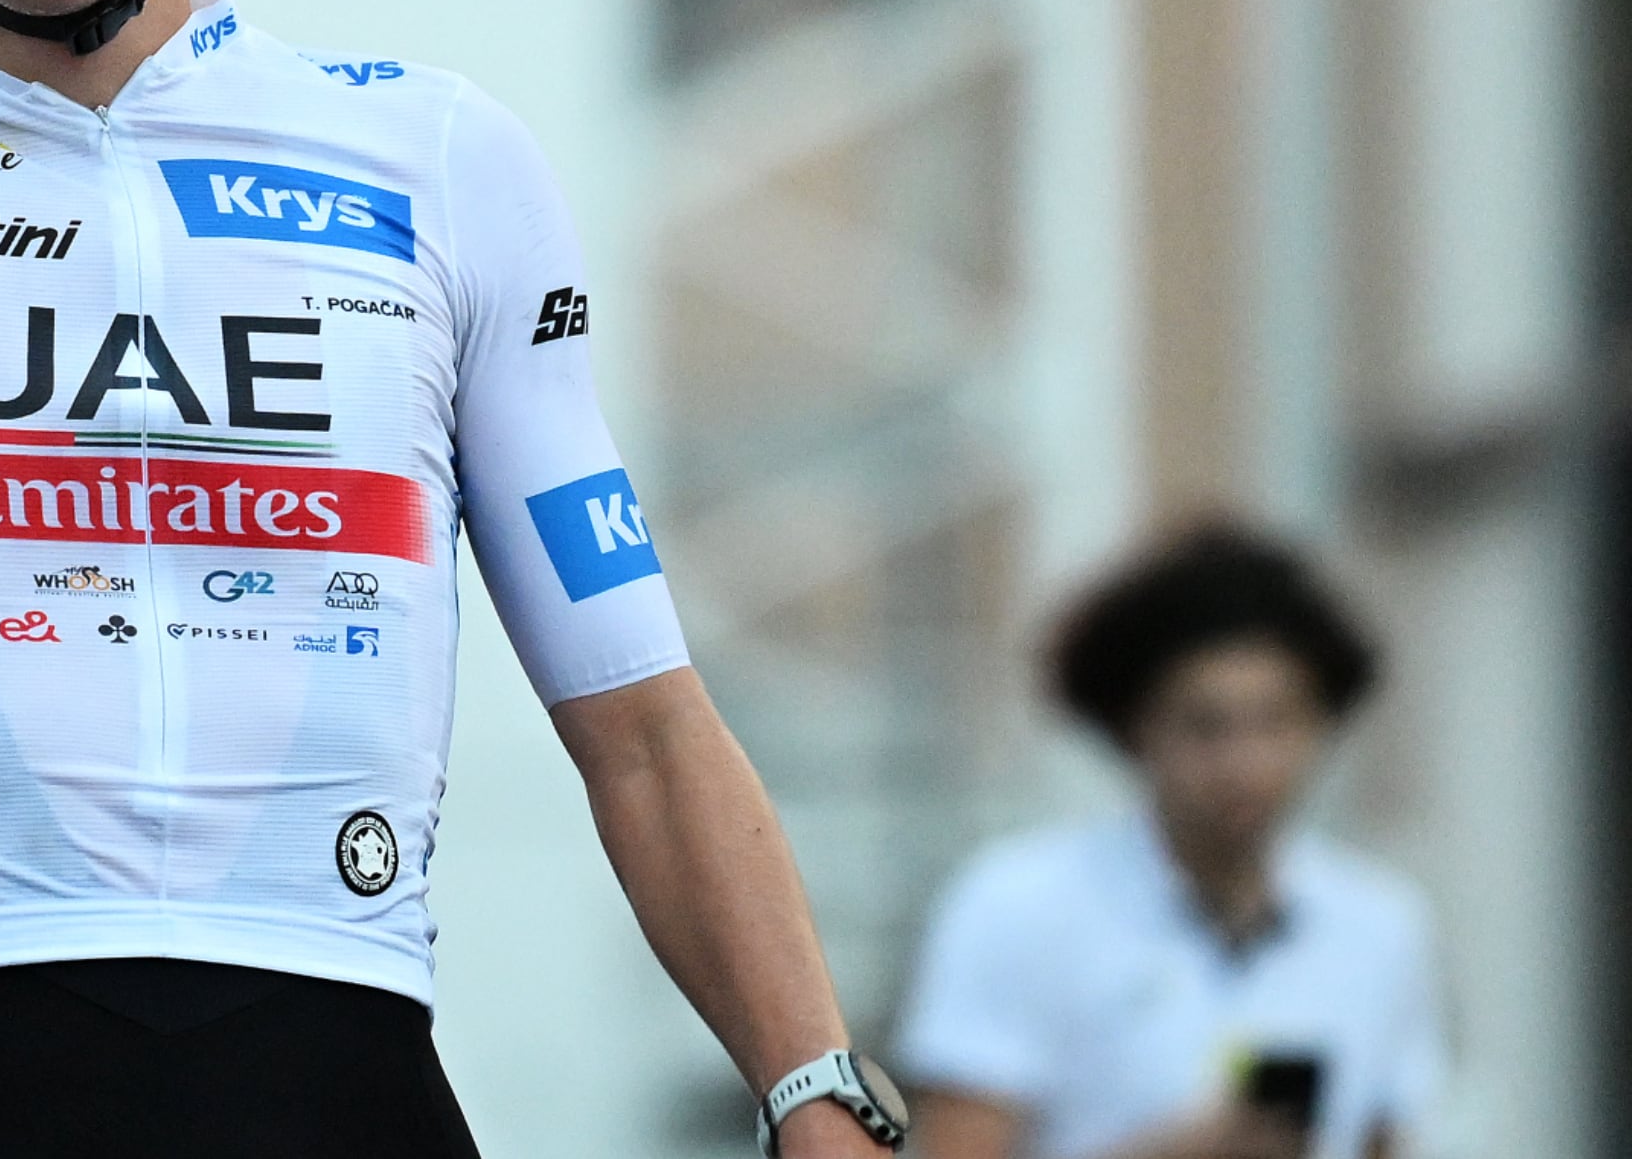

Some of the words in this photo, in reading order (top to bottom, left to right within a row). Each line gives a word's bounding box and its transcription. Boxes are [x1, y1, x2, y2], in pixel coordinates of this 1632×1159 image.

[190, 14, 237, 58] Krys
[318, 60, 405, 86] rys
[209, 173, 376, 231] Krys
[301, 296, 321, 310] T.
[328, 297, 417, 323] POGAČAR
[203, 570, 275, 603] G42
[326, 571, 379, 599] ADQ
[192, 627, 268, 641] PISSEI
[294, 643, 336, 653] ADNOC
